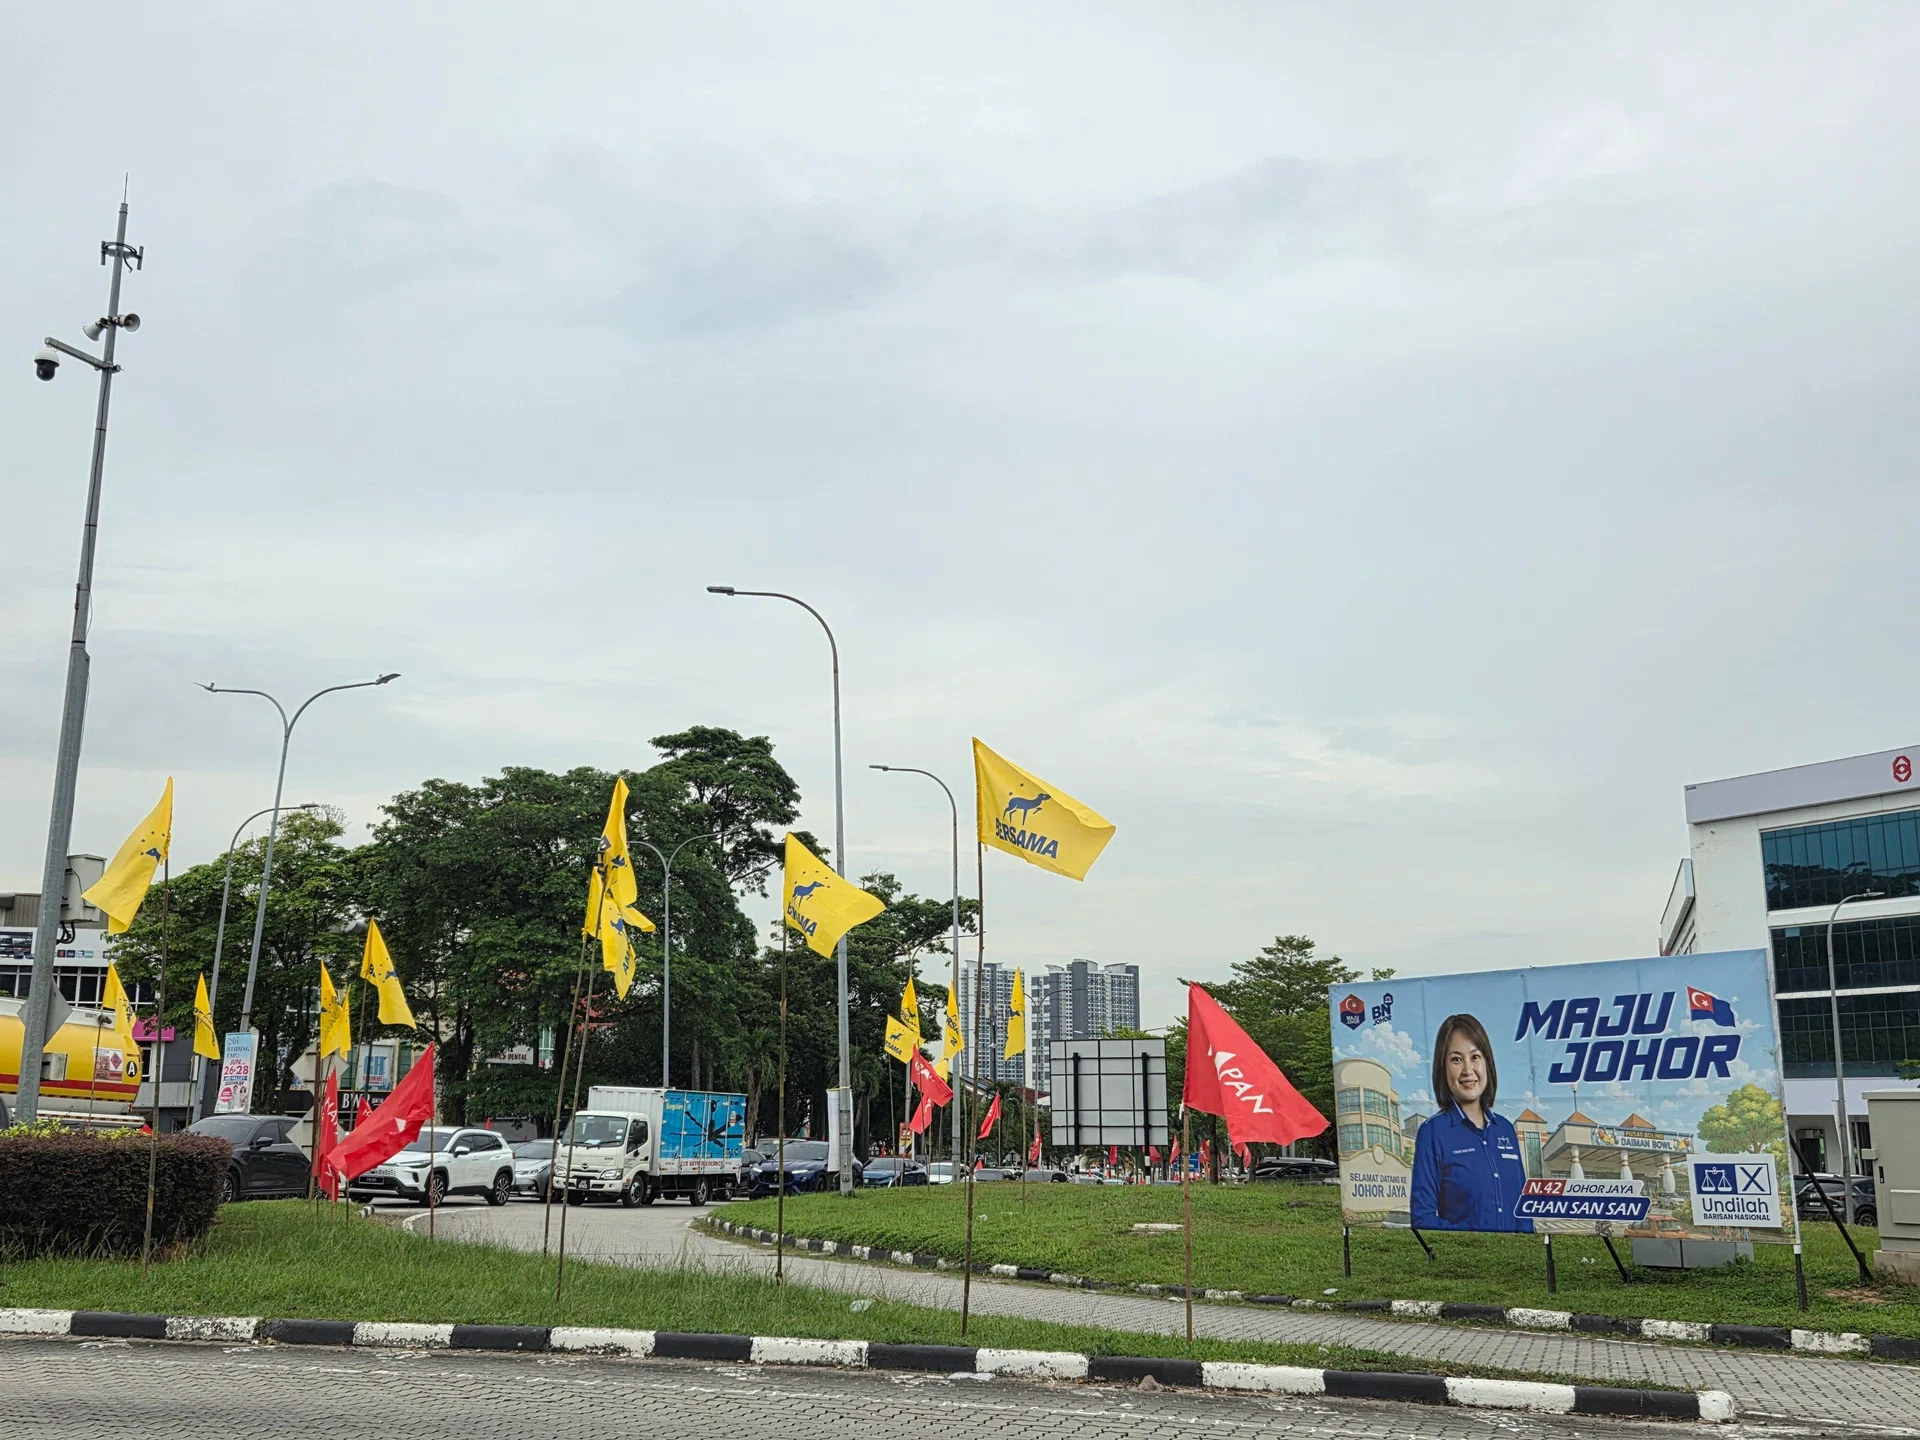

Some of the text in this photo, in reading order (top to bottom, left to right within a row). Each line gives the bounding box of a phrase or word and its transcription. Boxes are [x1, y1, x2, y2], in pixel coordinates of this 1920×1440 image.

[995, 816, 1059, 859] BERSAMA
[1372, 1003, 1391, 1020] BN
[1515, 991, 1676, 1042] MAJU
[1373, 1015, 1392, 1026] JOHOR
[1548, 1034, 1741, 1084] JOHOR
[128, 1062, 136, 1075] A
[1644, 1132, 1664, 1140] BOLING
[1620, 1138, 1673, 1150] DAIMAN BOWL
[1350, 1172, 1407, 1184] SELAMAT DATANG KE
[1352, 1183, 1406, 1198] JOHOR JAYA
[1528, 1181, 1634, 1194] N.42 JOHOR JAYA
[1522, 1200, 1642, 1216] CHAN SAN SAN
[1701, 1197, 1769, 1213] Undilah
